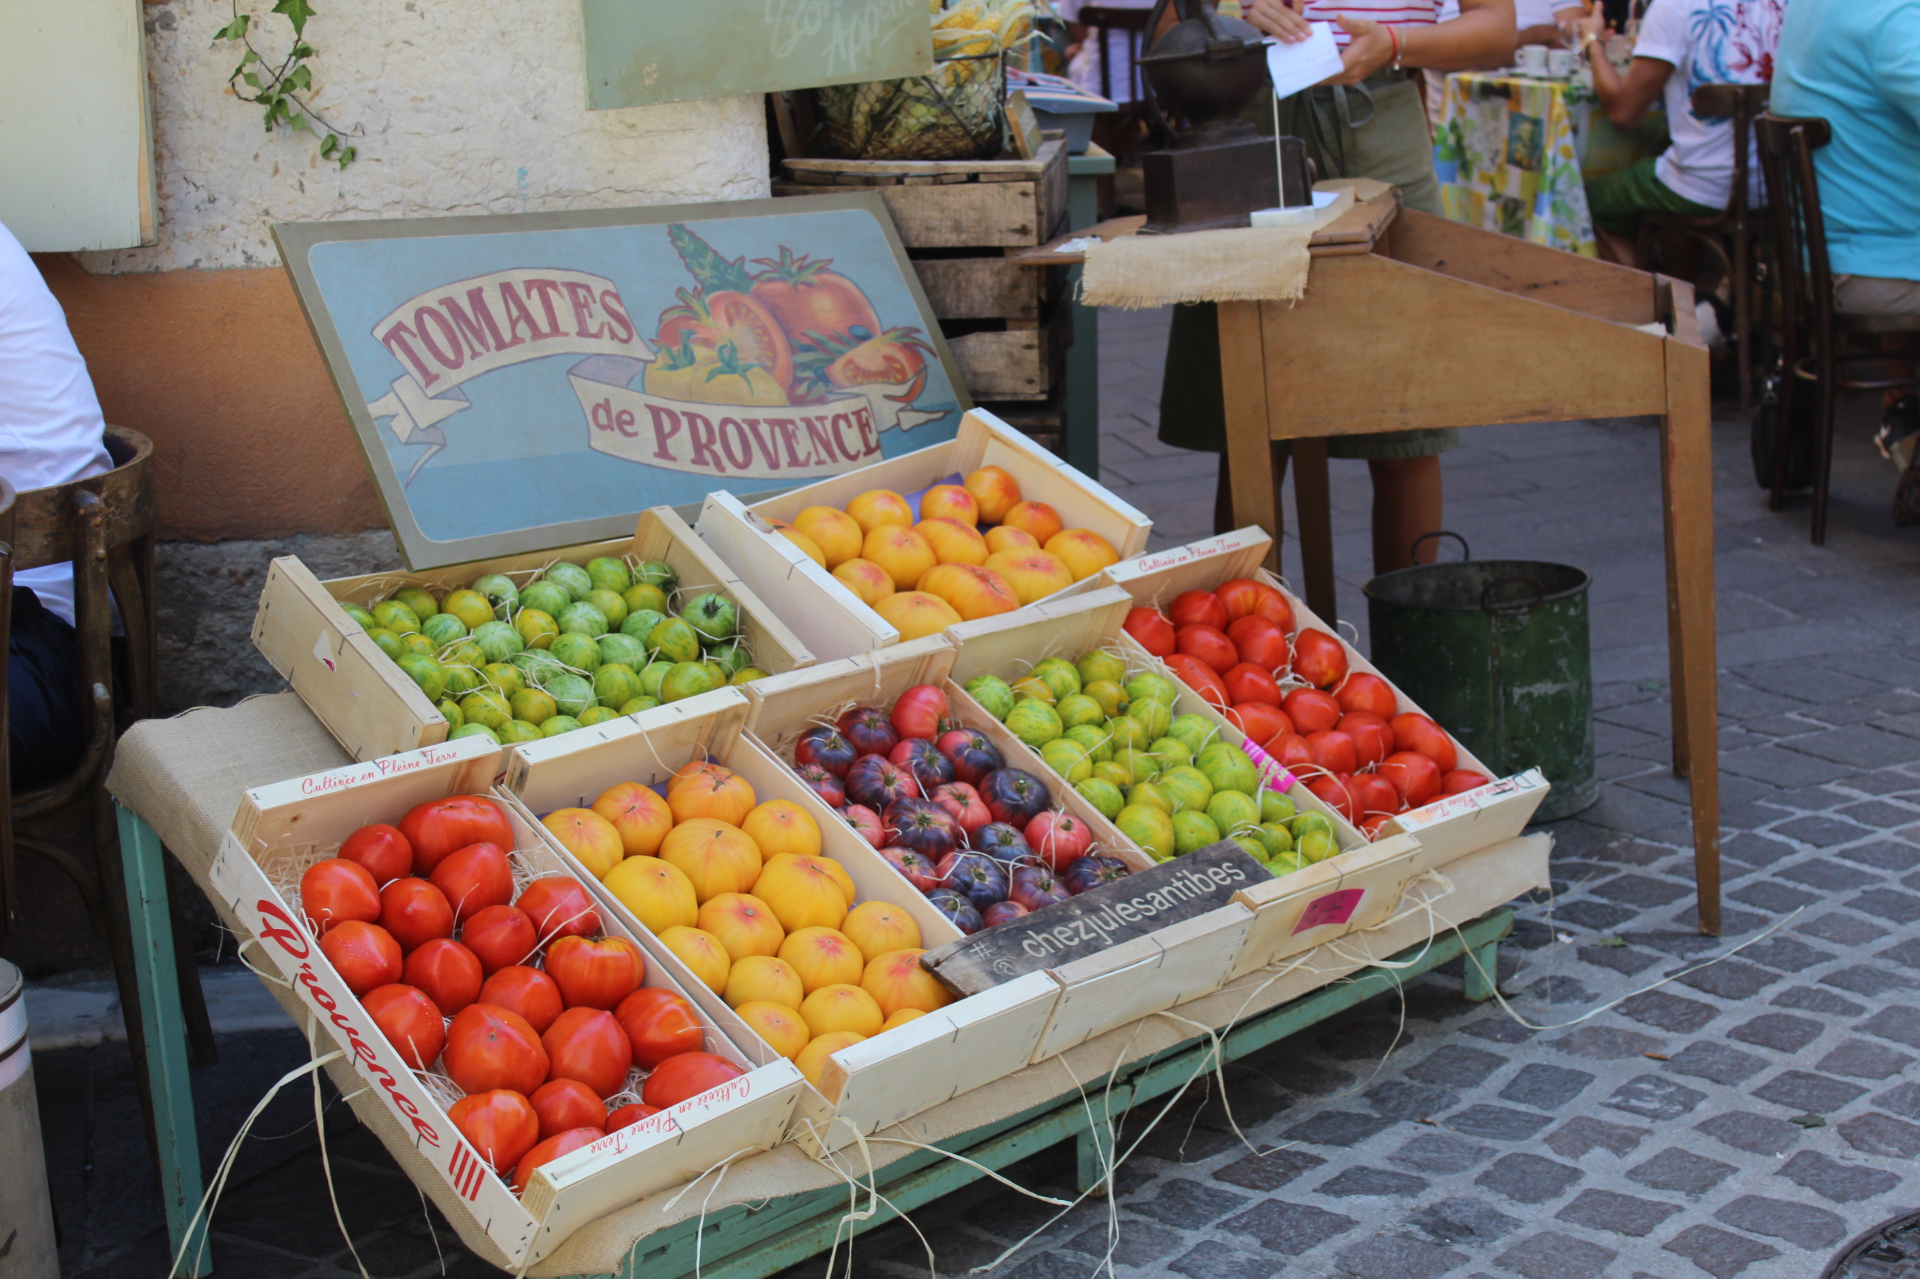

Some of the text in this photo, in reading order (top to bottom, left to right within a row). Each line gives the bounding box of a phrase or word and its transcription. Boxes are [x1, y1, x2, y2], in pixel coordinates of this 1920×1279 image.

[380, 278, 635, 390] TOMATES
[590, 397, 881, 473] de PROVENCE
[359, 770, 376, 782] en
[377, 759, 421, 776] Pleine
[420, 748, 458, 765] Terre
[1021, 861, 1247, 959] chezjulesantibes
[256, 899, 441, 1149] Provence
[630, 1110, 679, 1135] Pleine
[678, 1100, 693, 1114] en
[590, 1131, 629, 1156] Terre
